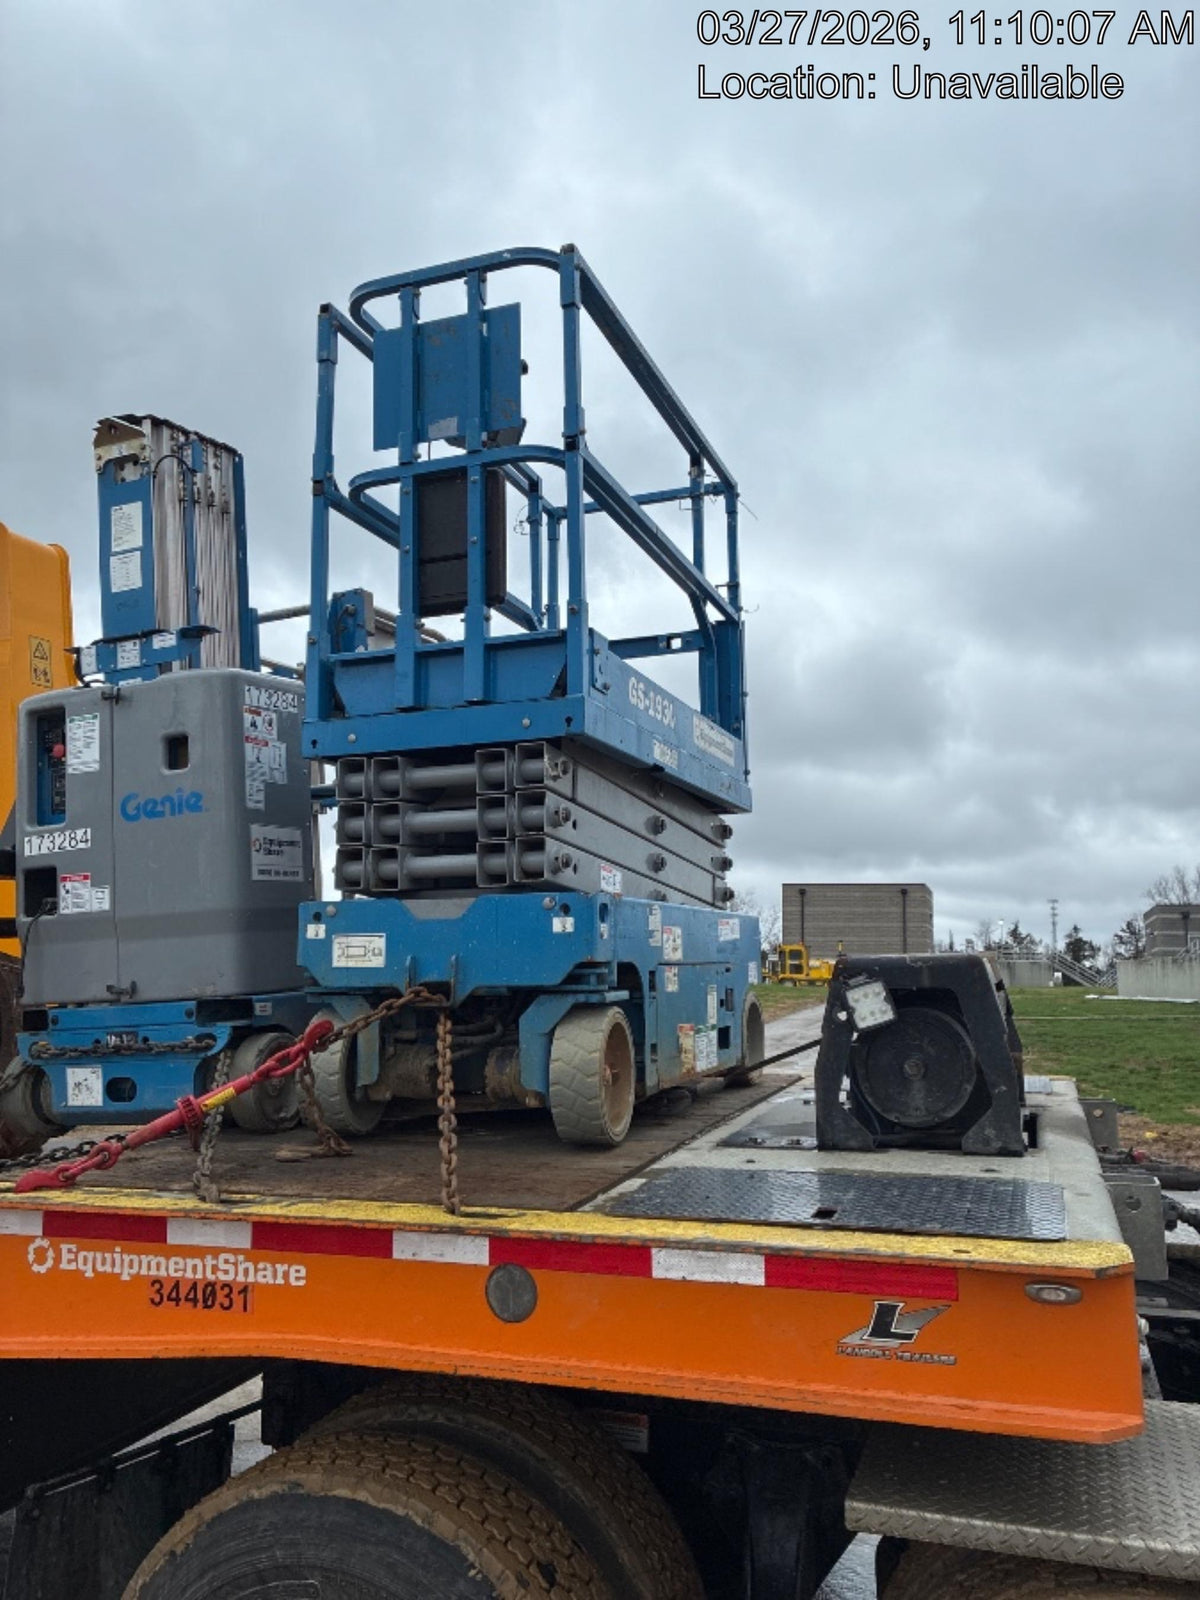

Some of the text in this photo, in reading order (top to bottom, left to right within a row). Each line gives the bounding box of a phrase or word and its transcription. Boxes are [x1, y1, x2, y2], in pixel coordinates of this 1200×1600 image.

[120, 787, 204, 822] Genie
[25, 829, 90, 855] 173284
[59, 1243, 307, 1286] EquipmentShare
